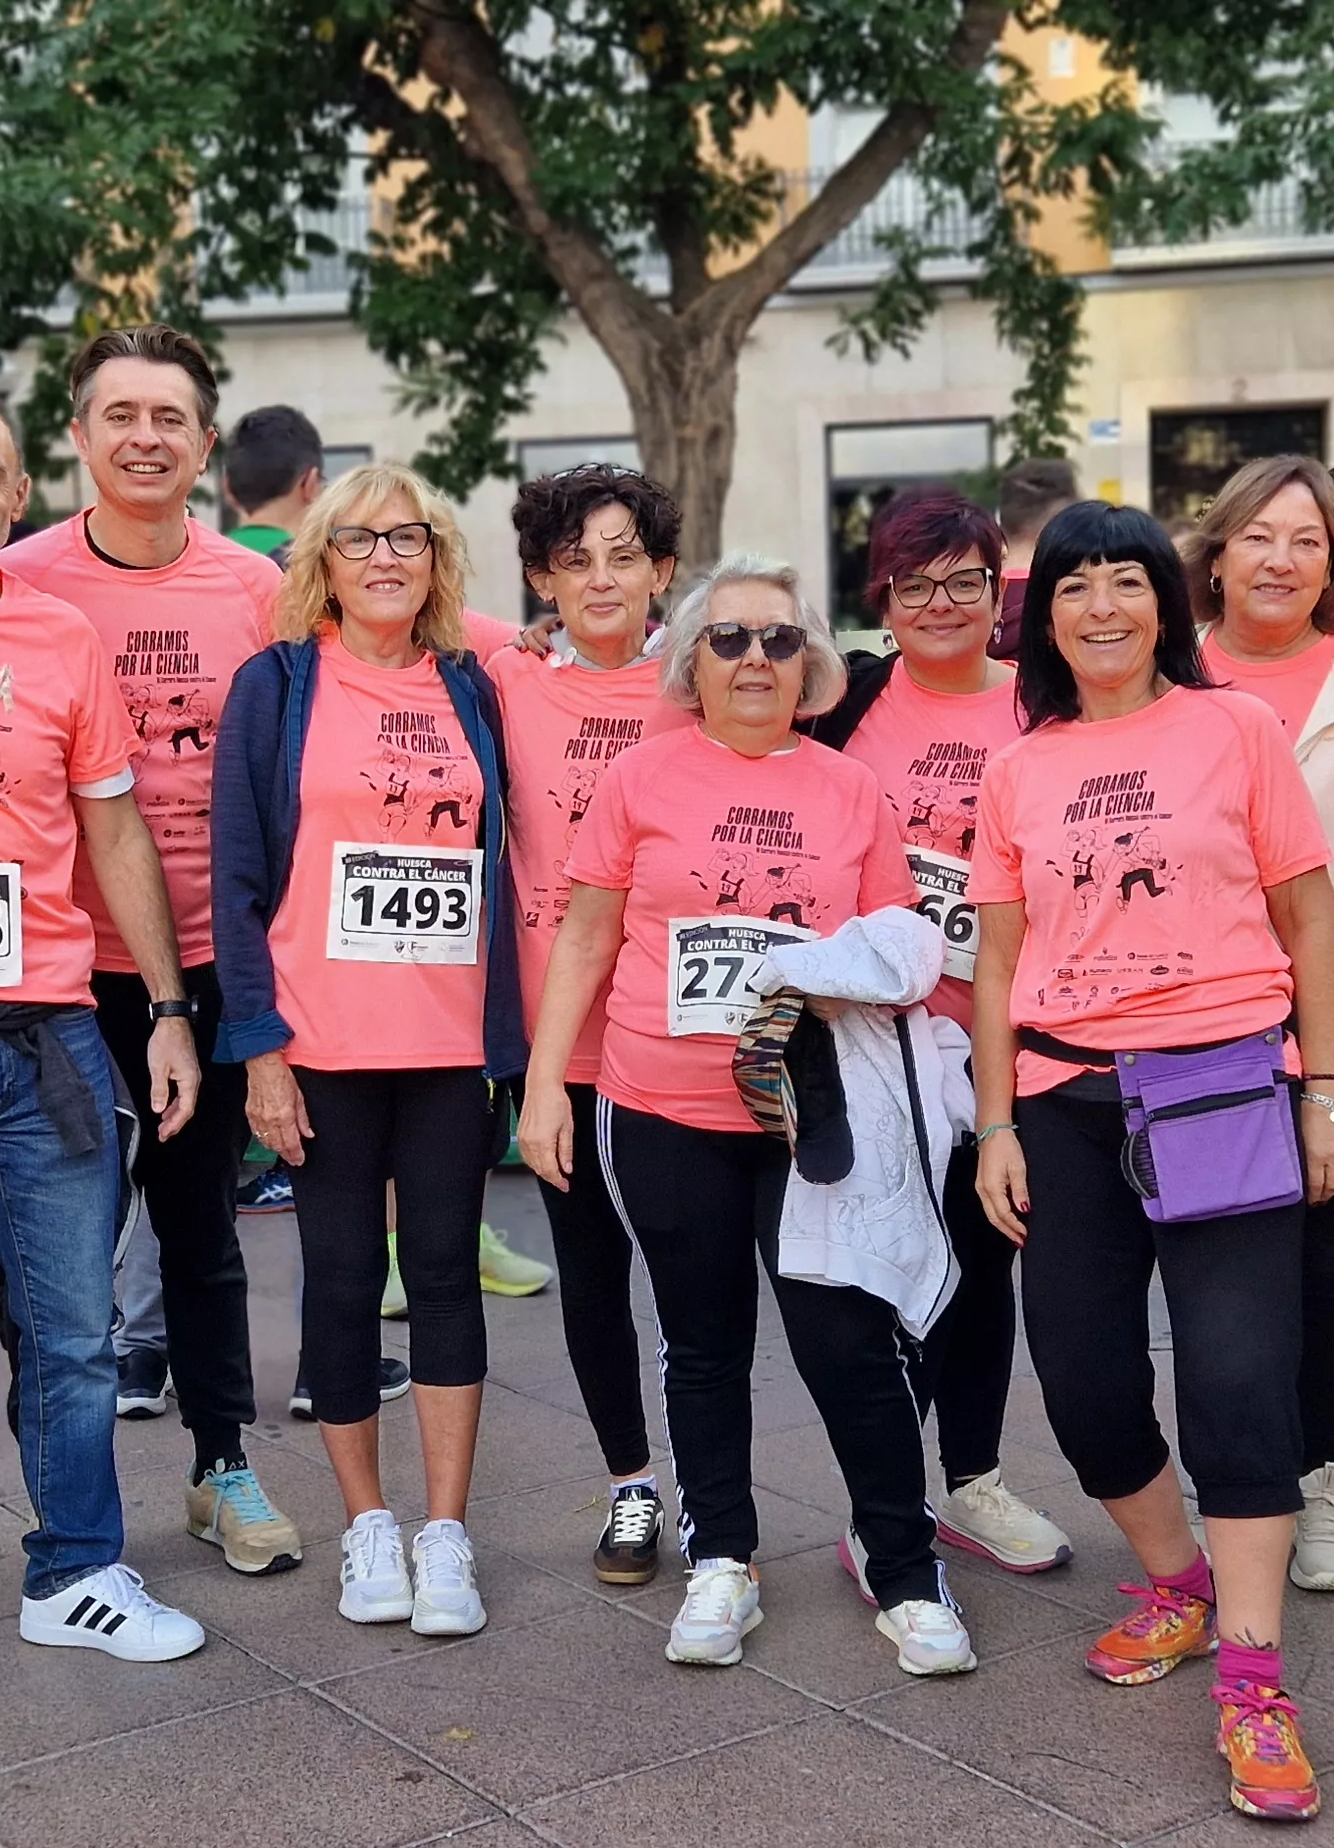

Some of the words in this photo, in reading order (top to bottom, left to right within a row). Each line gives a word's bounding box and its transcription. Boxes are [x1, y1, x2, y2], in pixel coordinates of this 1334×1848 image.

[127, 630, 189, 653] CORRAMOS
[114, 655, 137, 677] POR
[139, 653, 152, 675] LA
[156, 653, 199, 675] CIENCIA
[380, 711, 437, 735] CORRAMOS
[579, 716, 644, 740] CORRAMOS
[396, 735, 408, 750] LA
[411, 733, 451, 753] CIENCIA
[564, 739, 587, 760] POR
[589, 740, 602, 761] LA
[926, 742, 987, 762] CORRAMOS
[907, 759, 934, 777] POR
[933, 761, 949, 778] LA
[949, 761, 986, 780] CIENC
[1078, 770, 1148, 800] CORRAMOS
[727, 806, 795, 830] CORRAMOS
[1063, 801, 1087, 825] POR
[1089, 797, 1102, 819] LA
[1105, 791, 1155, 816] CIENCIA
[711, 824, 737, 843] POR
[739, 826, 753, 845] LA
[756, 828, 803, 850] CIENCIA
[352, 866, 407, 879] CONTRA
[409, 869, 422, 880] EL
[424, 866, 466, 881] CÁNCER
[397, 858, 433, 869] HUESCA
[911, 872, 945, 891] NTRA
[947, 881, 961, 894] EL
[938, 867, 969, 883] HUESC
[351, 885, 467, 930] 1493
[916, 894, 977, 944] 66
[687, 939, 738, 952] CONTRA
[741, 939, 755, 951] EL
[728, 928, 767, 941] HUESCA
